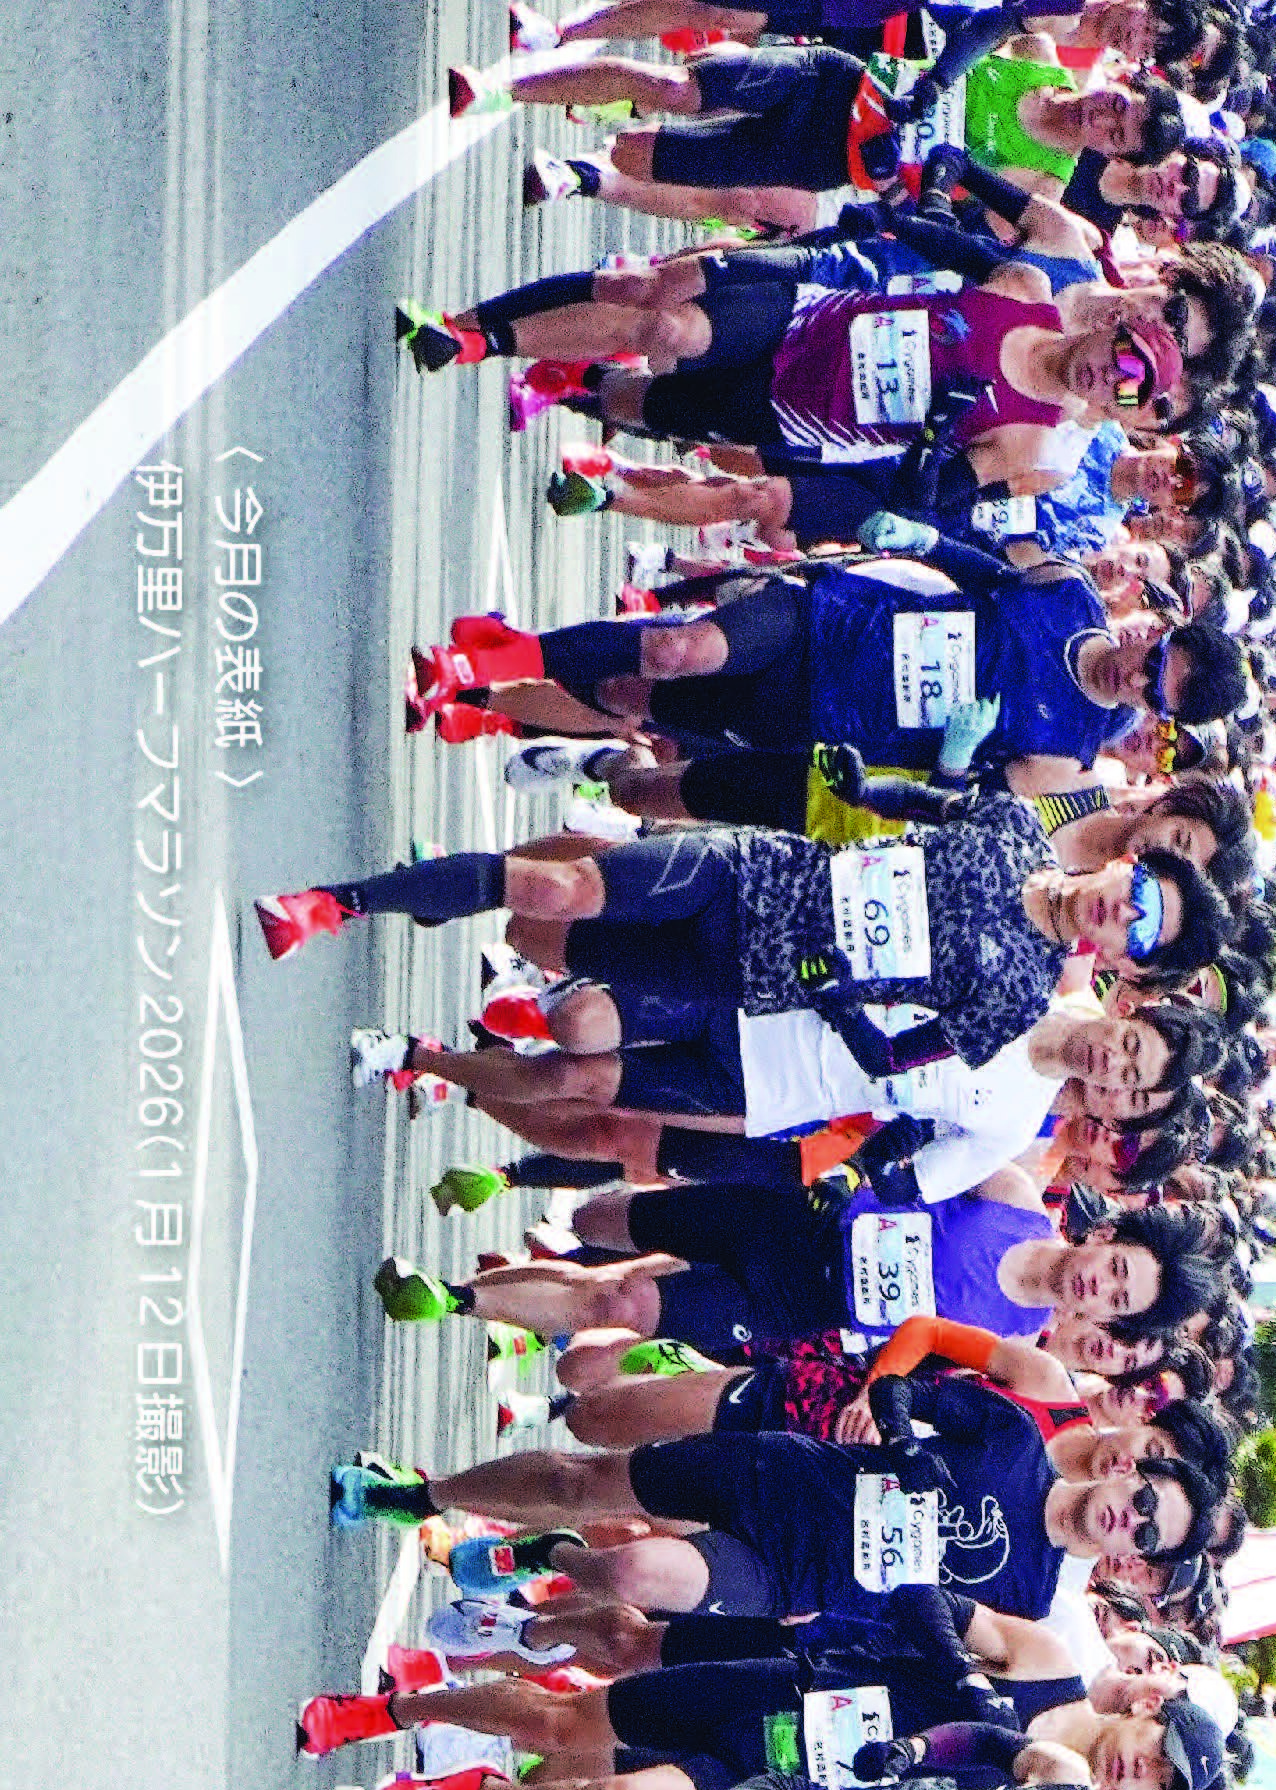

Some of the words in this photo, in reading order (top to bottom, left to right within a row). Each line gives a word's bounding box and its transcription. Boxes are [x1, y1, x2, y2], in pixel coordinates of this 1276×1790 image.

[875, 358, 900, 395] 13
[920, 660, 943, 699] 18
[864, 899, 891, 947] 69
[877, 1217, 898, 1232] A
[878, 1261, 901, 1301] 39
[880, 1525, 904, 1568] 56
[910, 1509, 925, 1573] Cygames
[831, 1695, 853, 1711] A
